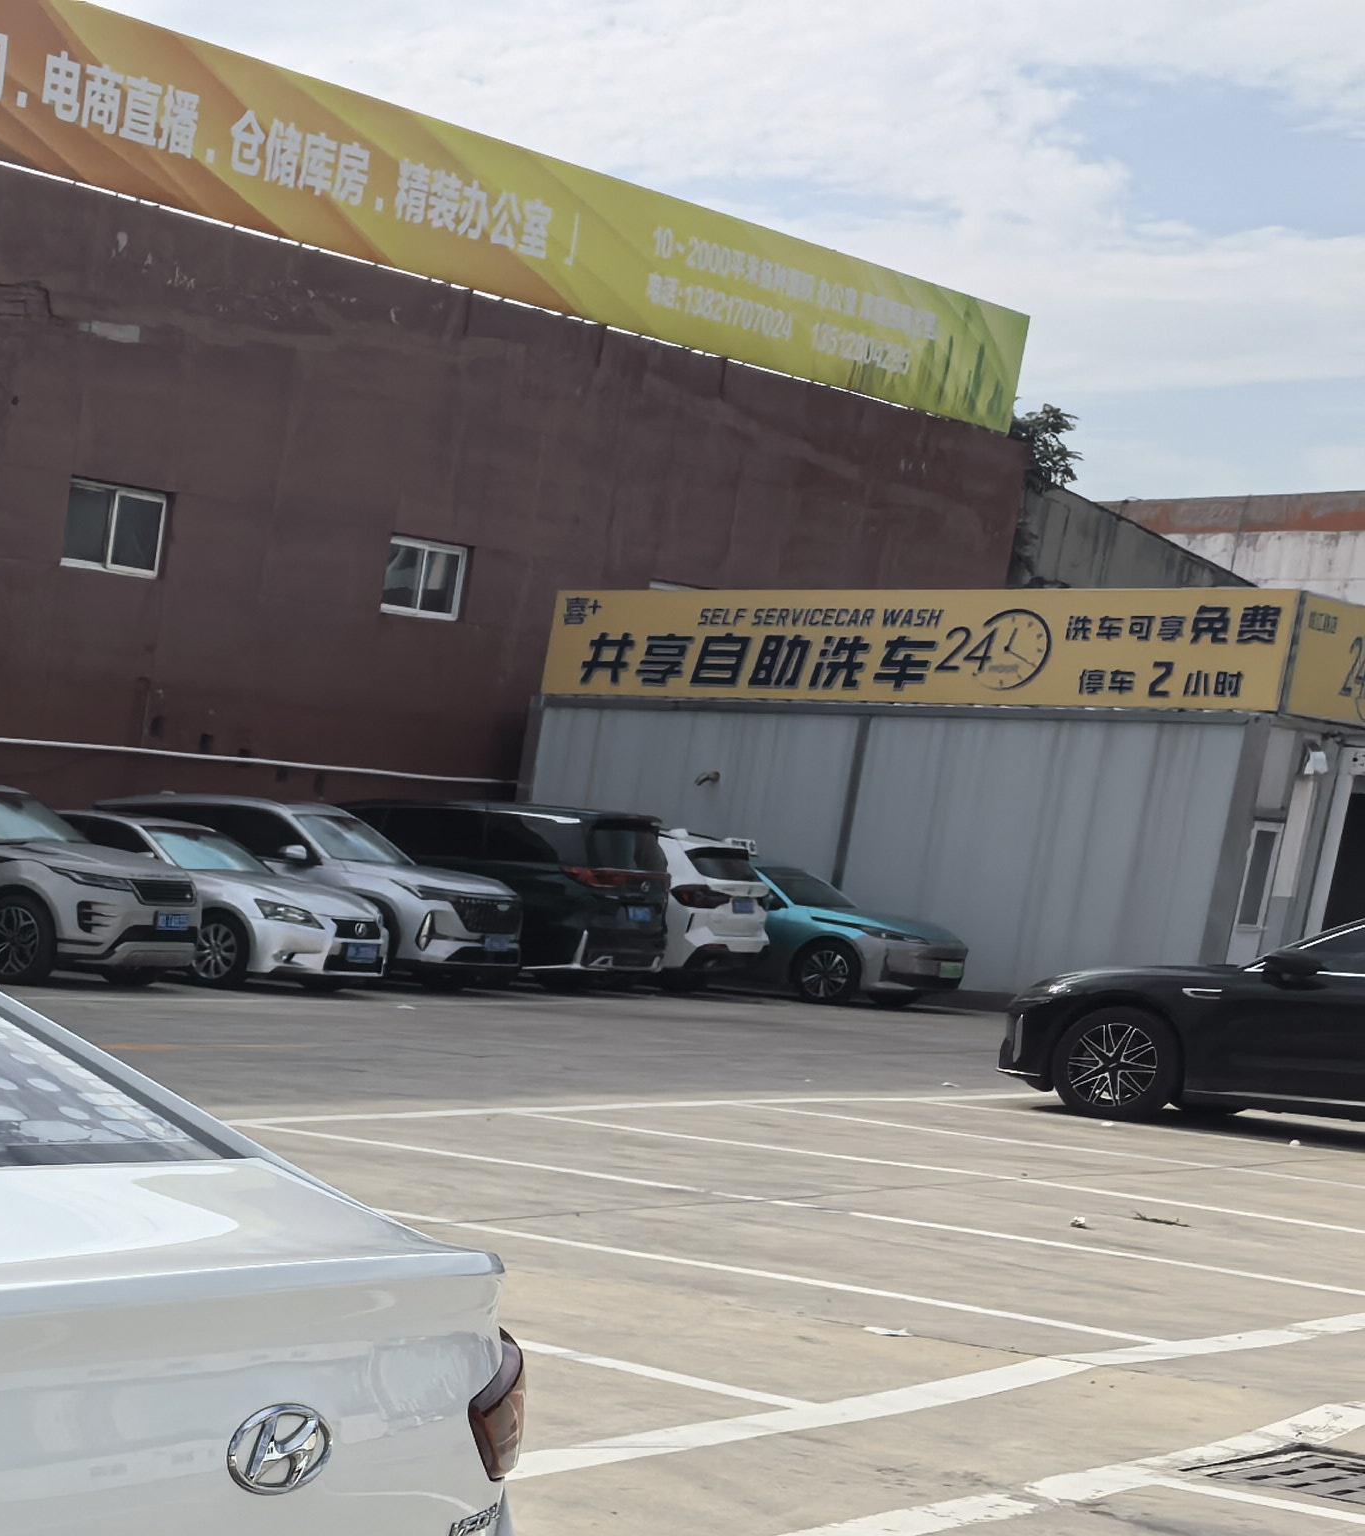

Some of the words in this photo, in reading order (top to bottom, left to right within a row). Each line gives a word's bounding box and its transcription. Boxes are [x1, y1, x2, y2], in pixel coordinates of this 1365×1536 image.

[697, 607, 748, 627] SELF
[750, 607, 876, 628] SERVICECAR
[881, 607, 945, 629] WASH
[1065, 604, 1282, 646] 洗车可享免费
[579, 631, 939, 691] 共享自助洗车
